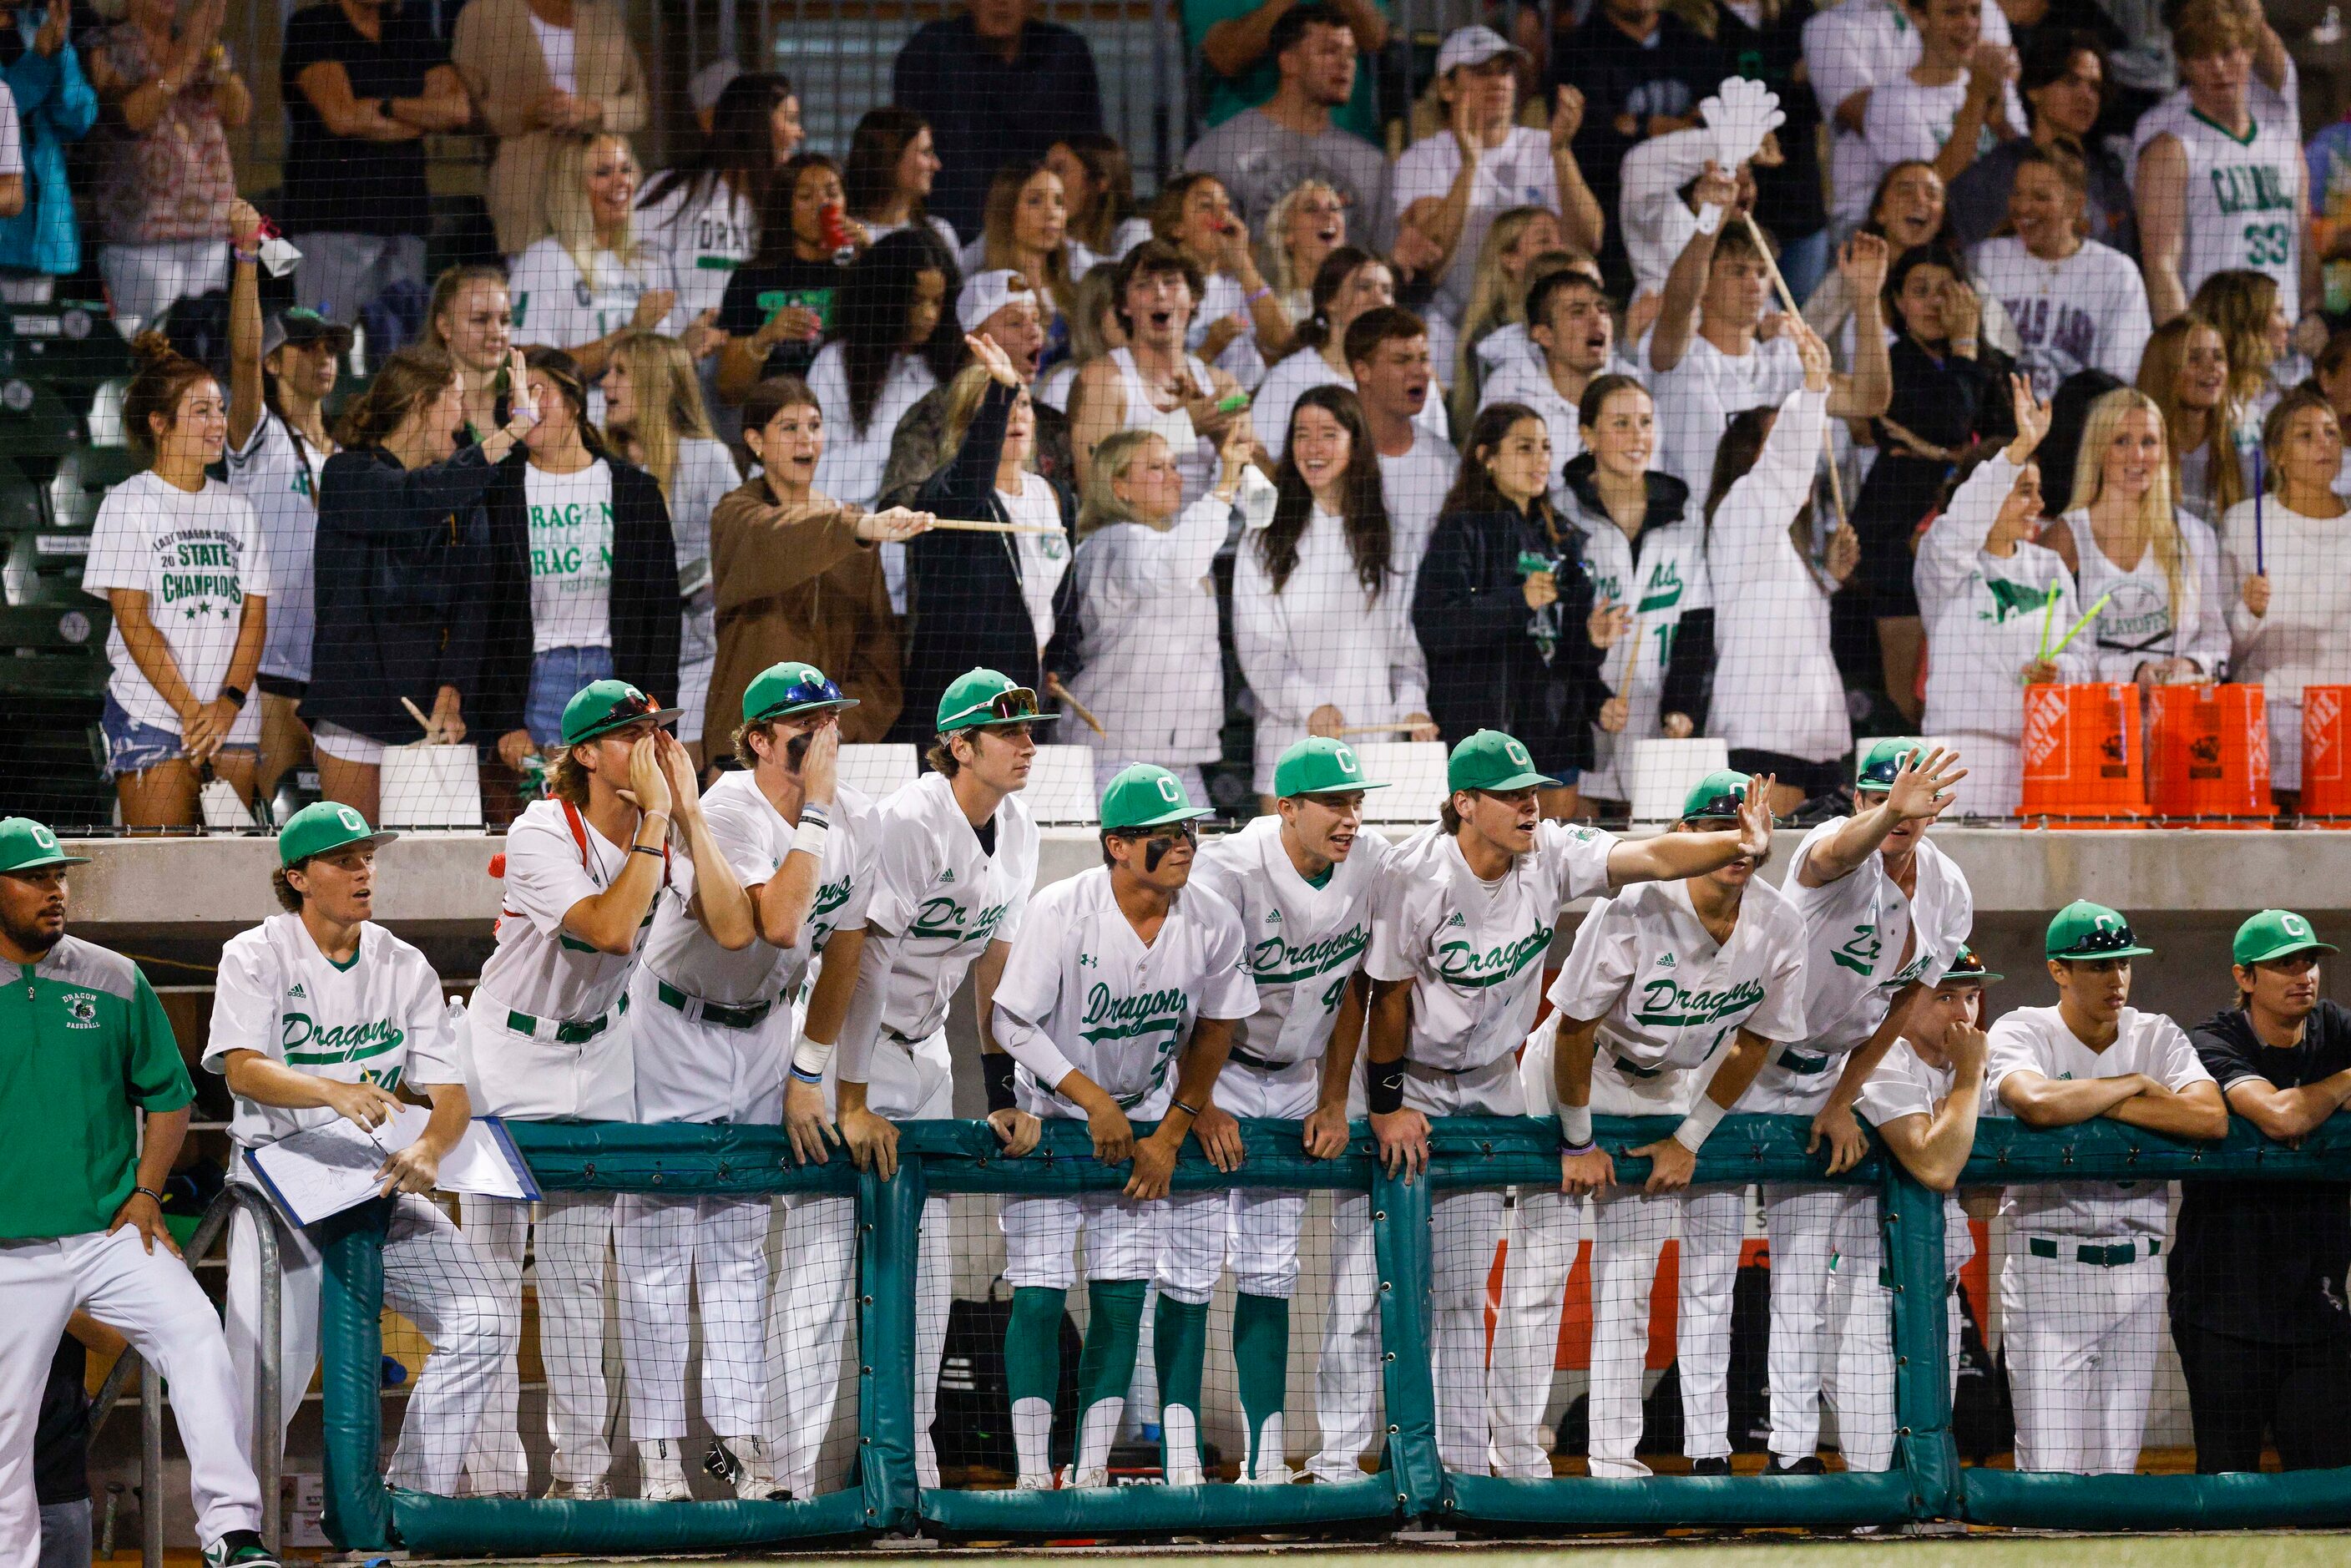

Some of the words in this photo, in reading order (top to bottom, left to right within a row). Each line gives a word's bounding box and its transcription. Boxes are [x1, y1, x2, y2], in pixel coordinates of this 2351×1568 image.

[2244, 222, 2289, 265] 33
[153, 531, 175, 551] LADY
[161, 555, 175, 568] 20
[177, 544, 231, 566] STATE
[2095, 606, 2170, 637] PLAYOFFS
[1336, 748, 1356, 773] C
[1505, 741, 1527, 766] C
[1157, 776, 1179, 802] C
[336, 808, 361, 832] C
[30, 826, 54, 849] C
[2280, 915, 2304, 936] C
[1252, 922, 1368, 974] Dragons
[62, 992, 97, 1003] DRAGON
[1081, 981, 1188, 1035] Dragons
[1643, 978, 1763, 1024] Dragns
[66, 1021, 101, 1029] BASEBALL
[282, 1012, 403, 1062] Dragons
